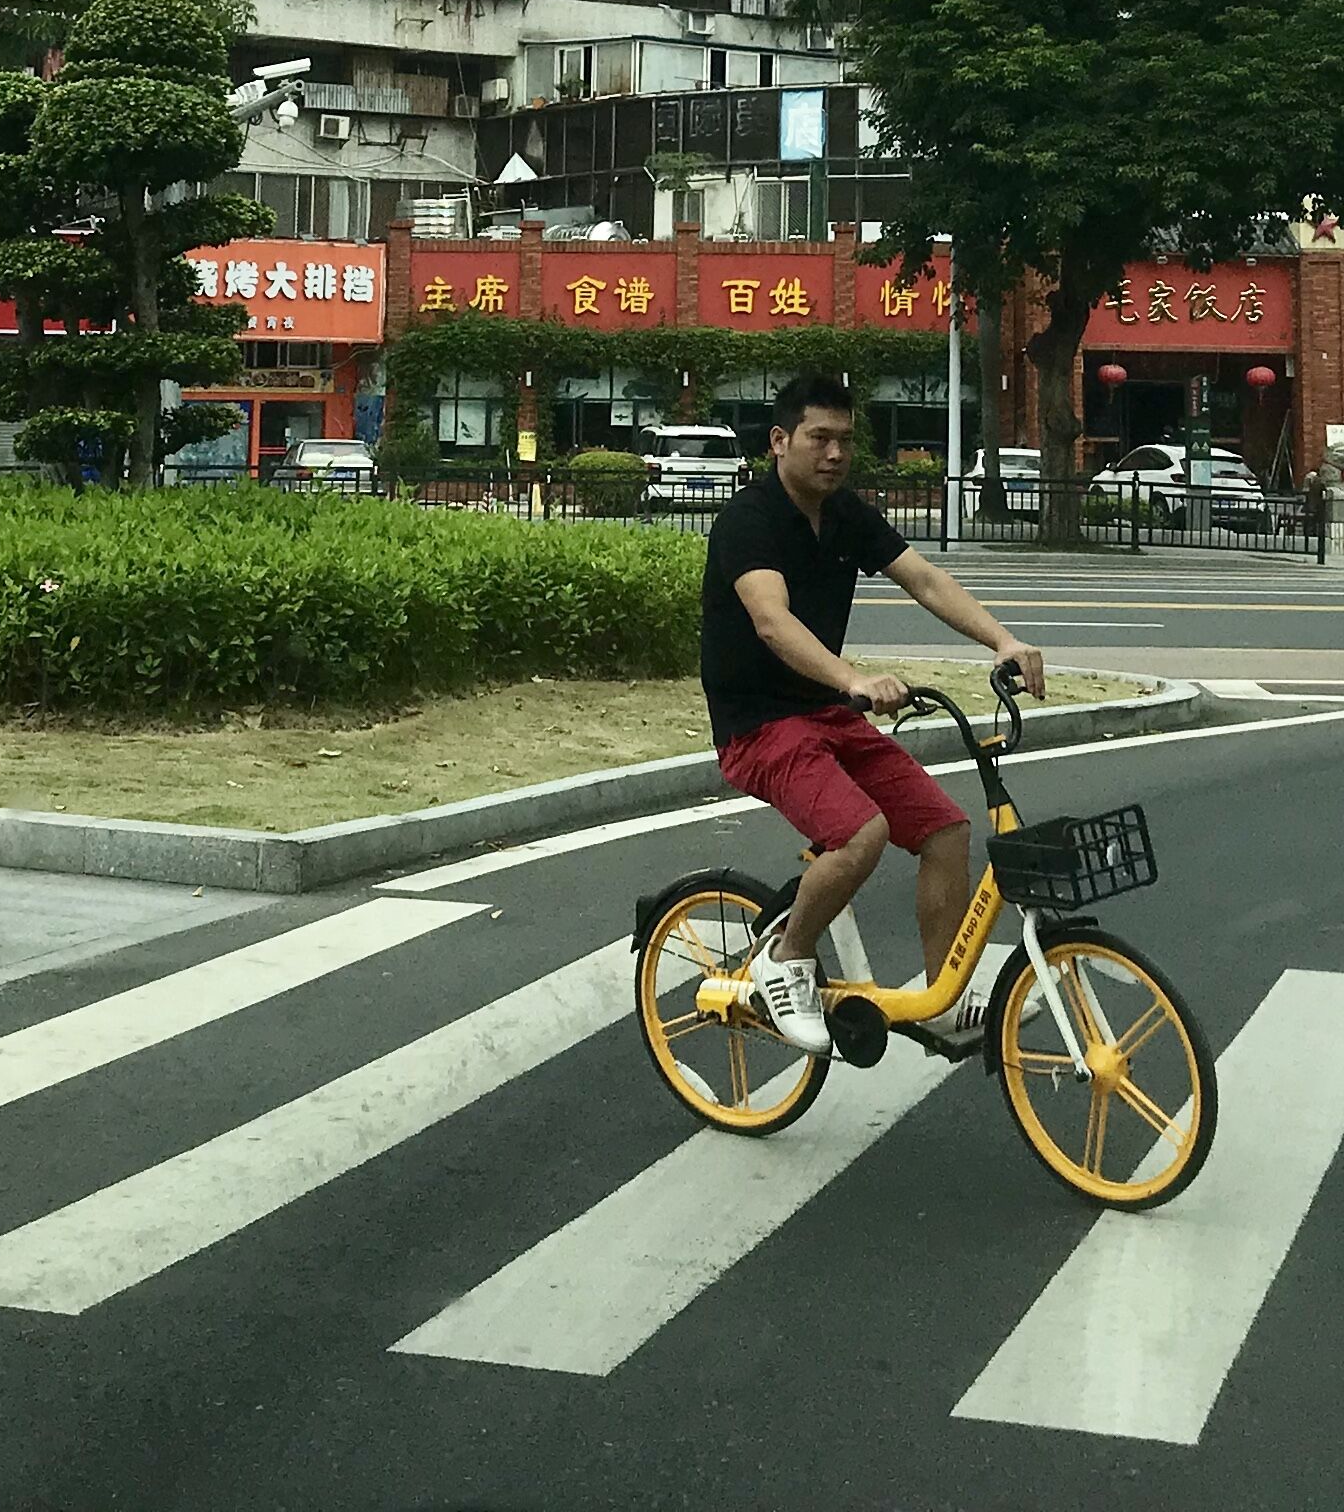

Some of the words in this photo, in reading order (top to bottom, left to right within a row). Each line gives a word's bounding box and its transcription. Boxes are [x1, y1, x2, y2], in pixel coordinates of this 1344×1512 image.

[419, 274, 509, 314] 主席
[567, 275, 655, 316] 食谱
[722, 276, 811, 316] 百姓
[1105, 279, 1267, 324] 毛家饭店
